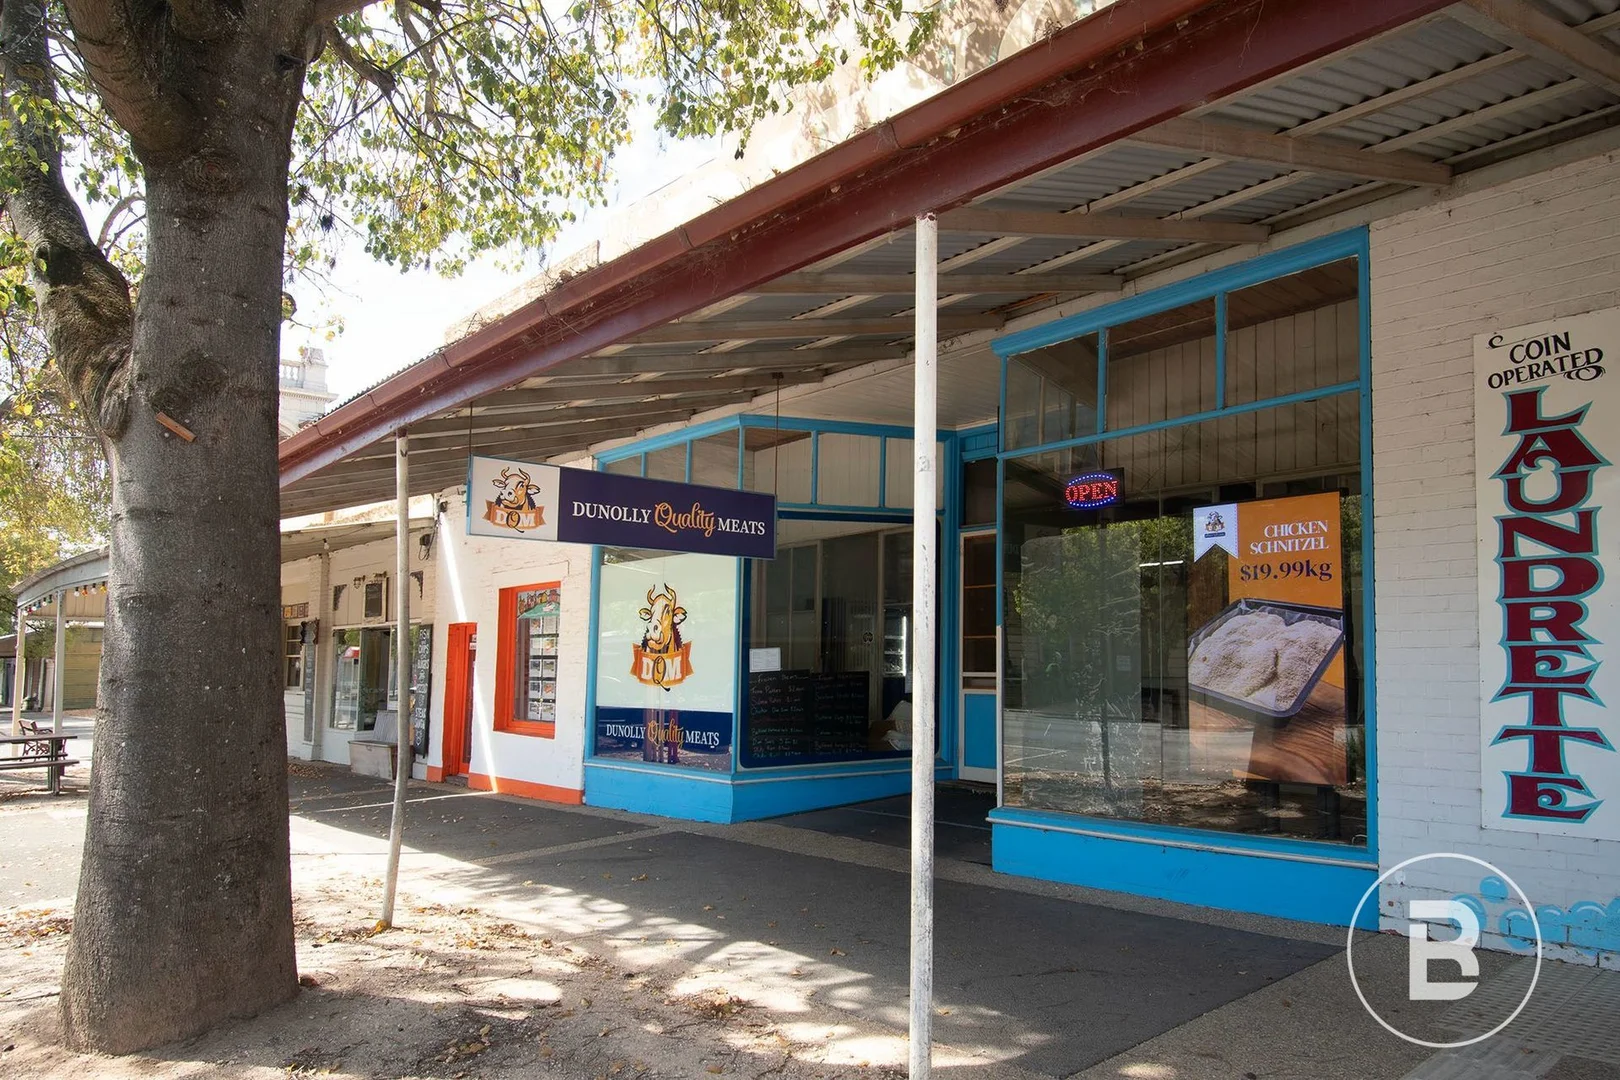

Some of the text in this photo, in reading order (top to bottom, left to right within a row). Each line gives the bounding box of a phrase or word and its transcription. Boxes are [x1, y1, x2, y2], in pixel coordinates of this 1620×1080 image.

[1509, 331, 1572, 365] COIN
[1487, 347, 1603, 389] OPERATED
[1065, 481, 1118, 502] OPEN
[571, 501, 766, 538] DUNOLLY Quality MEATS
[1263, 520, 1329, 538] CHICKEN
[1249, 536, 1330, 555] SCHNITZEL
[1240, 559, 1333, 583] $19.99kg
[1488, 385, 1618, 825] LAUNDRETTE
[605, 718, 720, 749] DUNOLLY Quality MEATS
